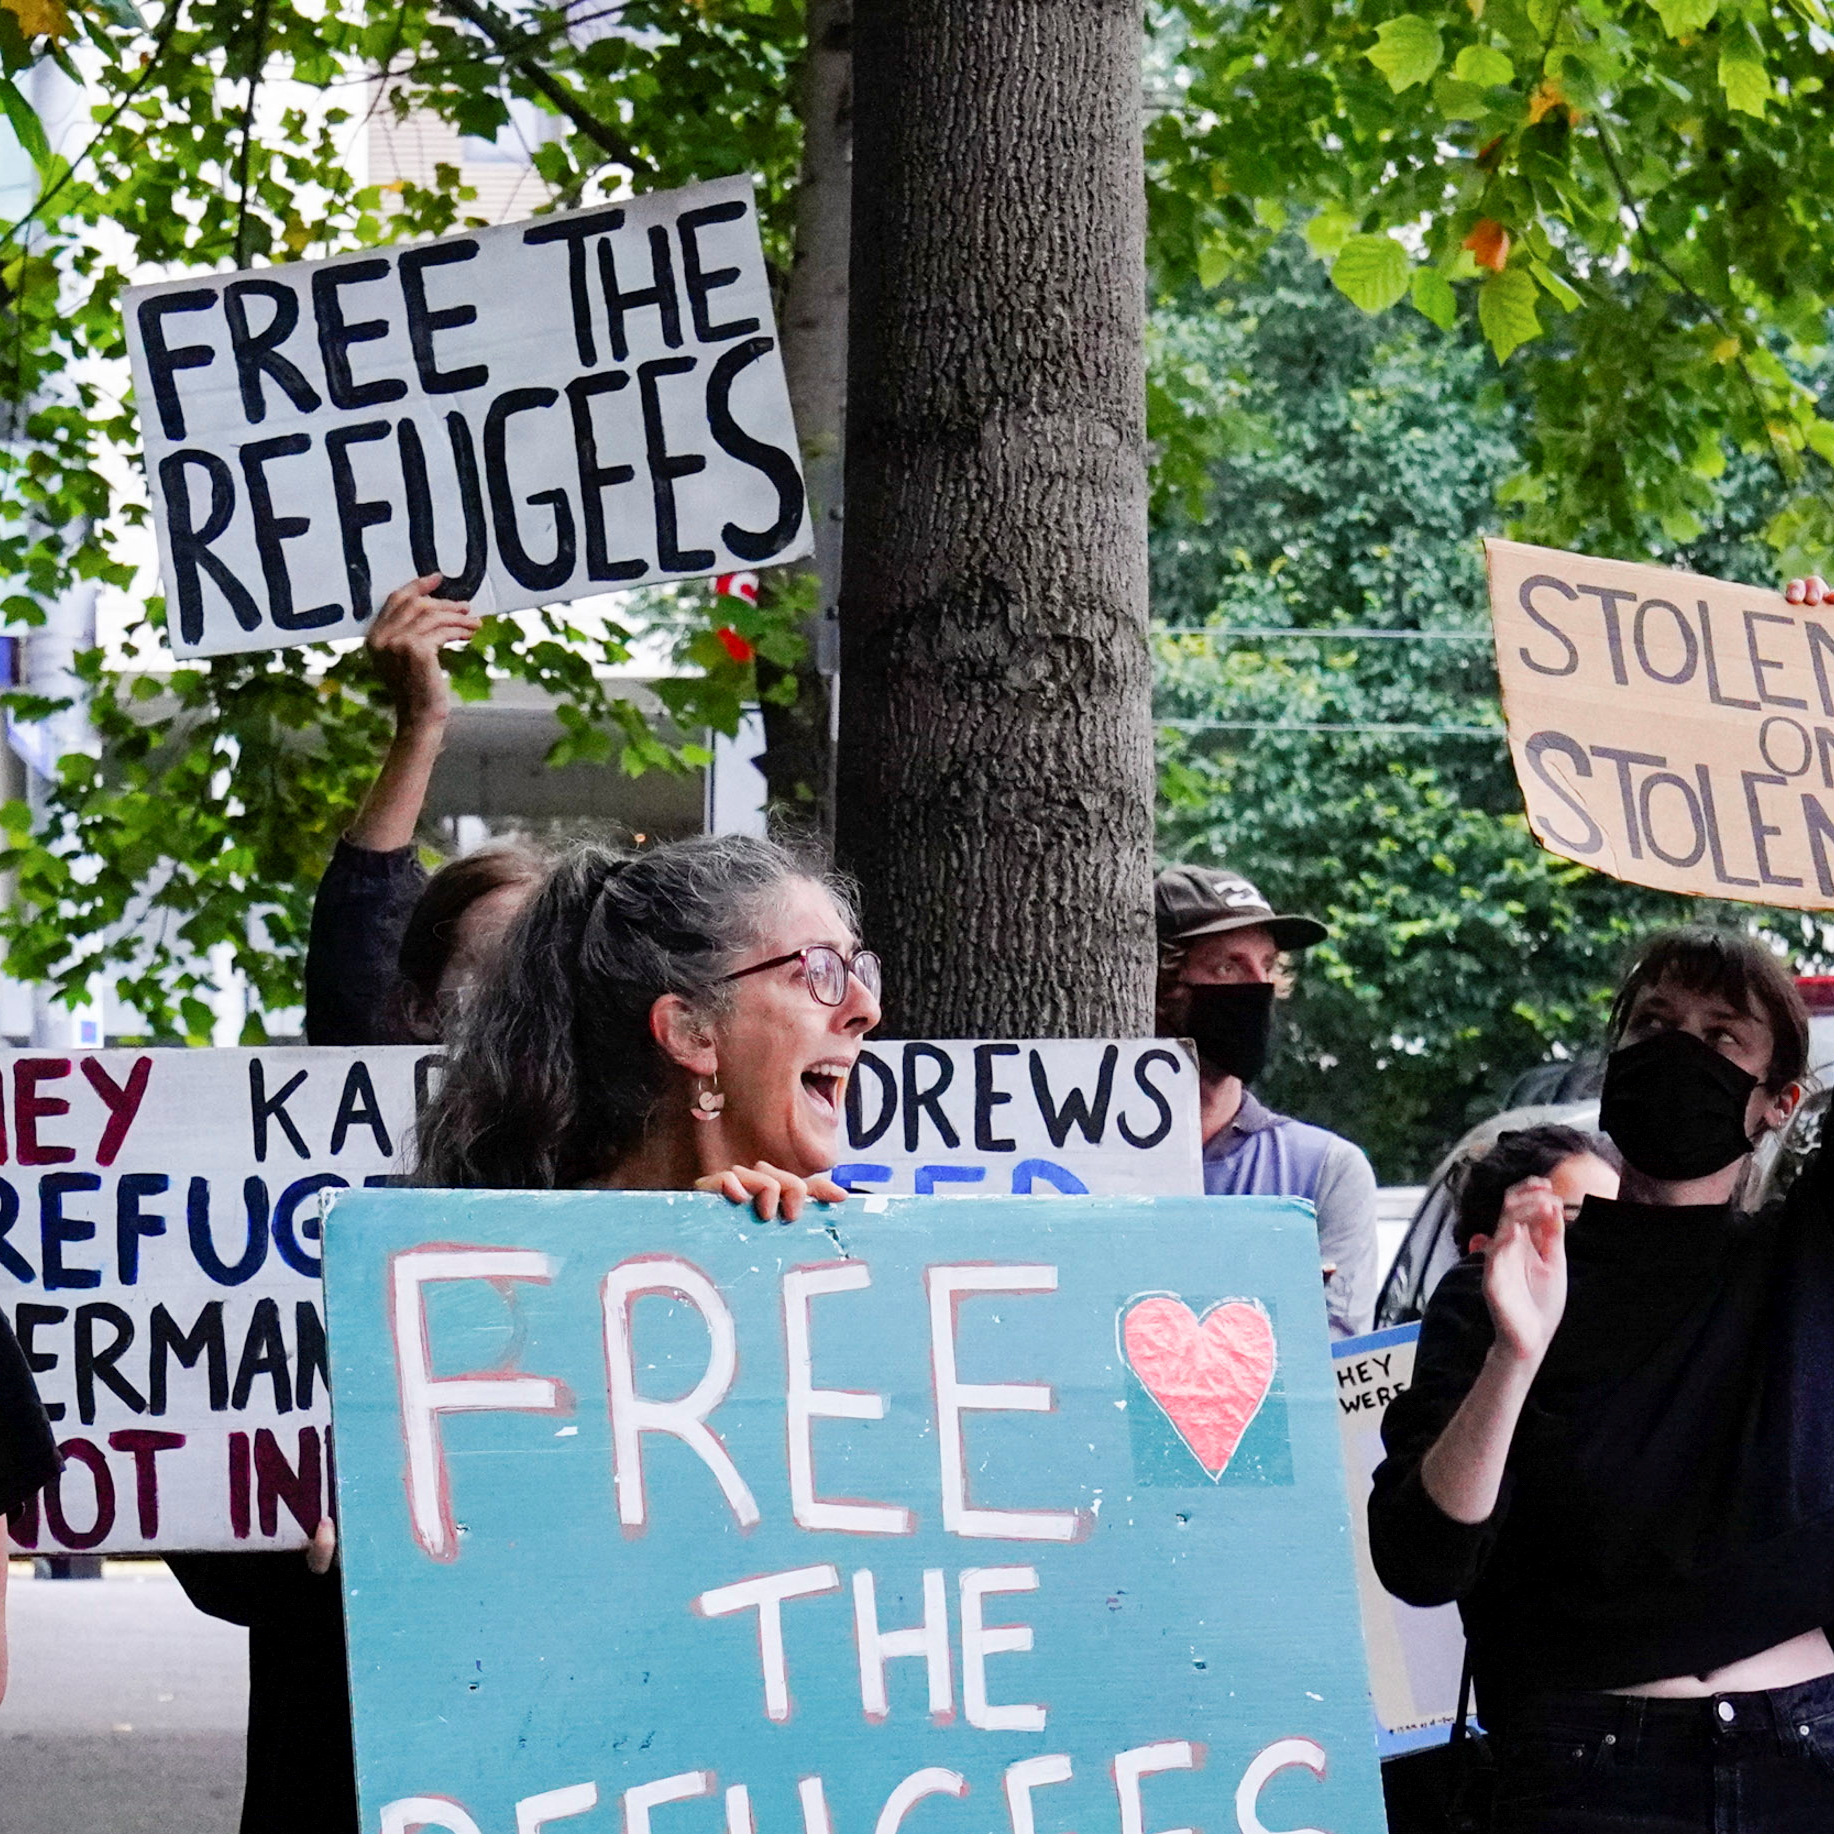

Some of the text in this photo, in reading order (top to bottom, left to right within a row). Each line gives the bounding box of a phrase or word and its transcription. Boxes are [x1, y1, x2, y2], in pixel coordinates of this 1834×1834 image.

[137, 200, 761, 441] FREE THE
[158, 336, 805, 646] REFUGEES
[390, 1243, 1095, 1561] FREE
[1337, 1353, 1391, 1389] HEY
[228, 1424, 337, 1540] IN
[695, 1564, 1048, 1731] THE
